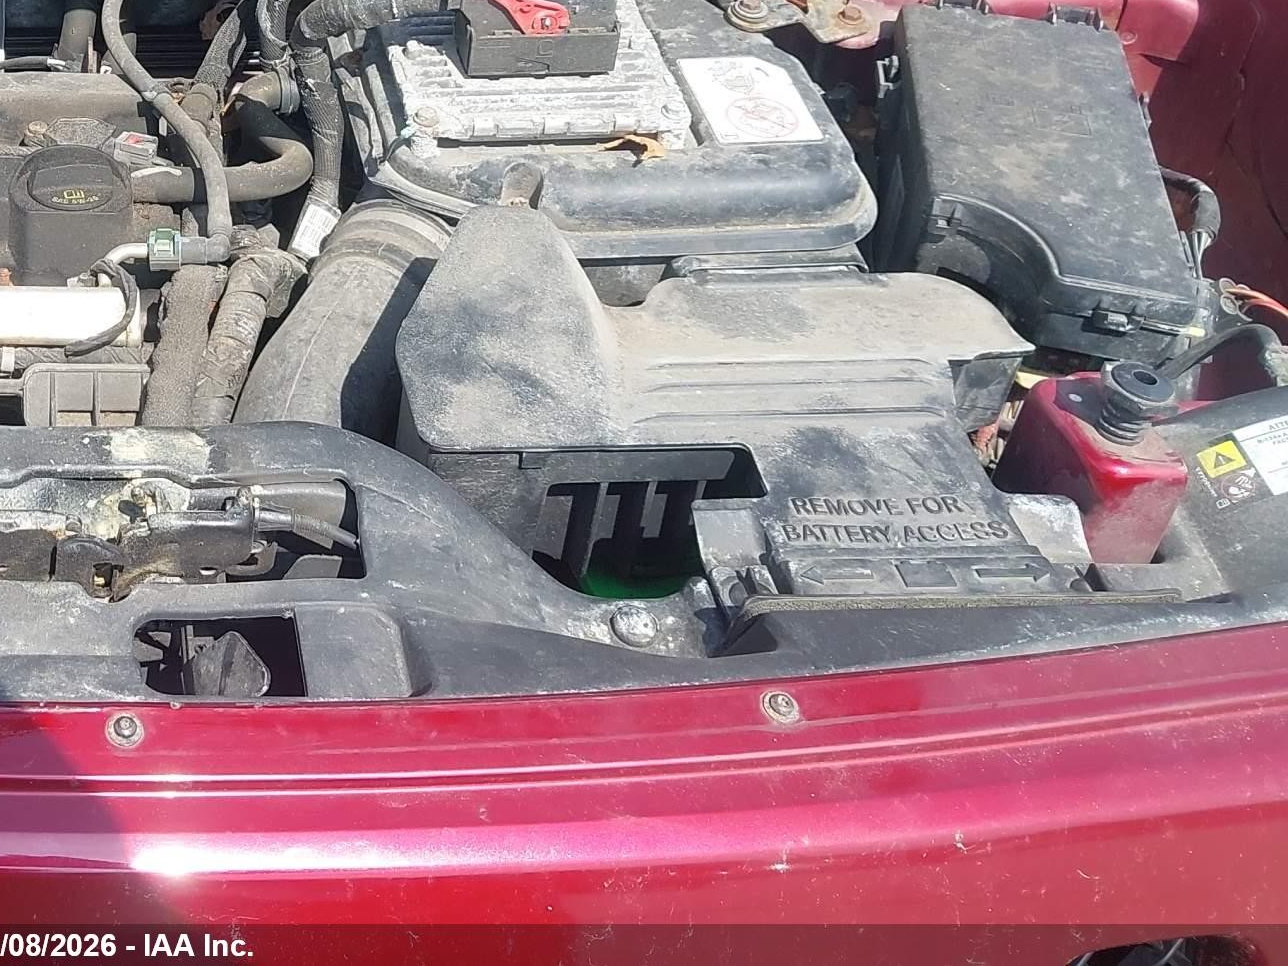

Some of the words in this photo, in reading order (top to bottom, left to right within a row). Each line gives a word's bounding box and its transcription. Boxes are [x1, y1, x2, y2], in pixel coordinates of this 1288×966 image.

[789, 497, 903, 516] REMOVE
[906, 495, 964, 514] FOR
[781, 524, 891, 542] BATTERY
[903, 521, 1009, 542] ACCESS
